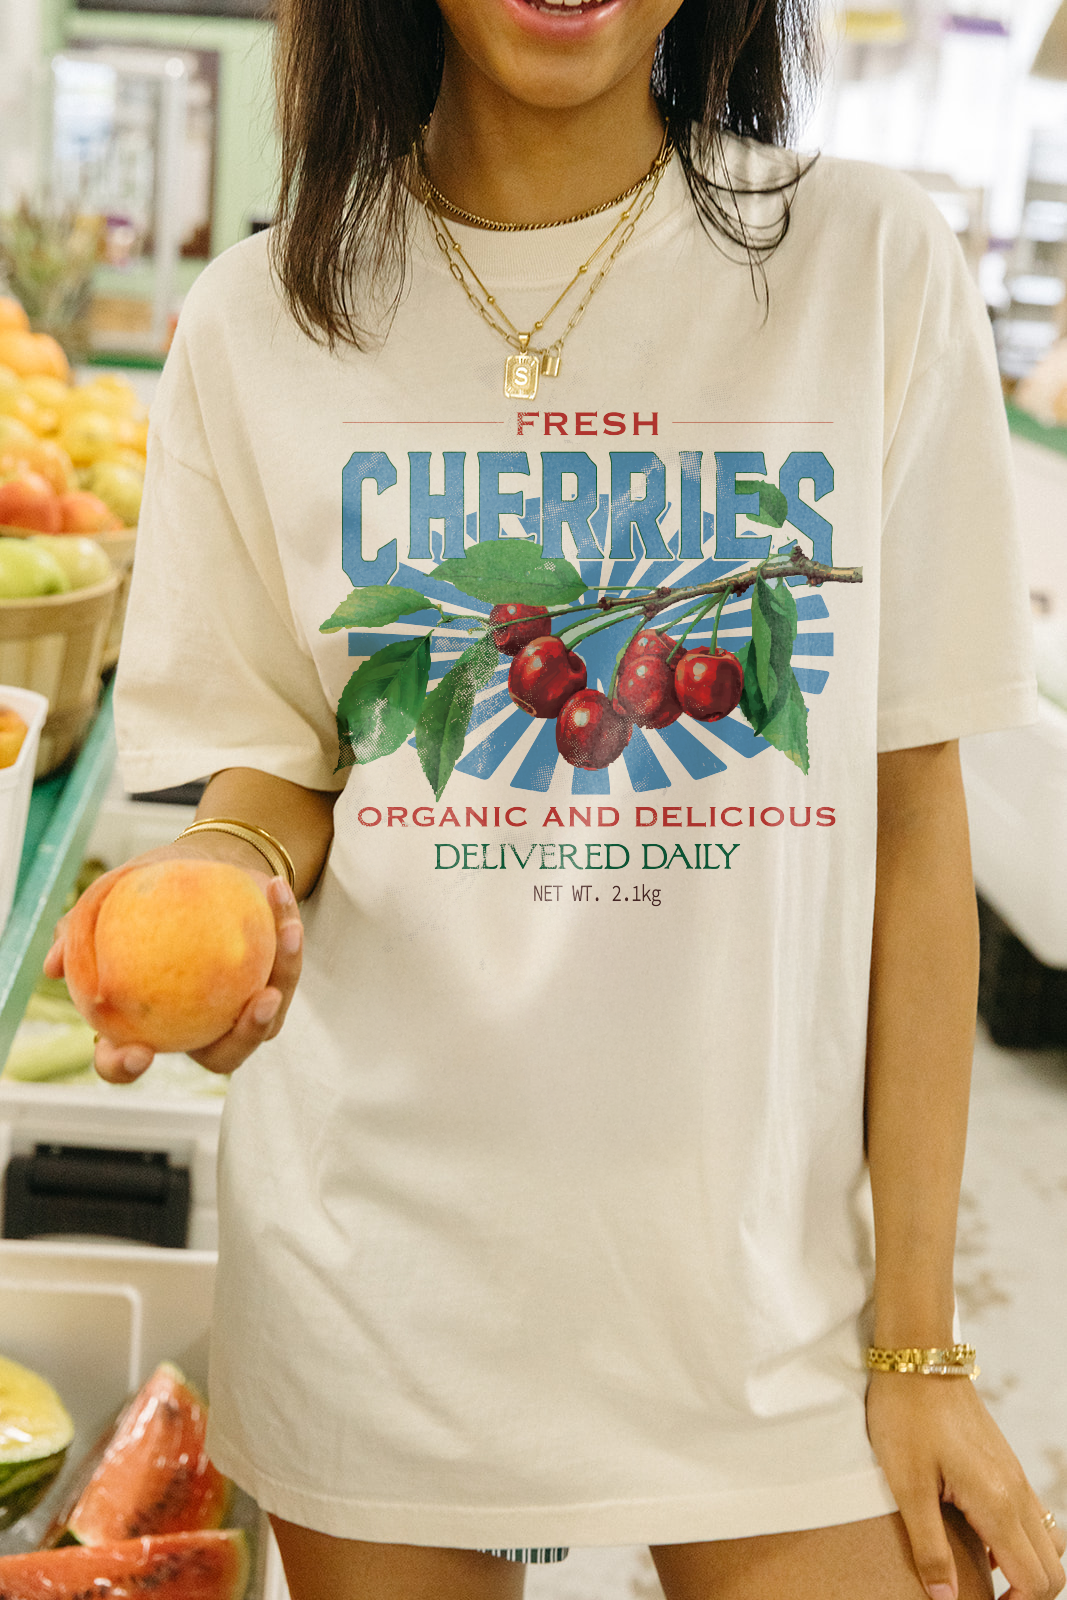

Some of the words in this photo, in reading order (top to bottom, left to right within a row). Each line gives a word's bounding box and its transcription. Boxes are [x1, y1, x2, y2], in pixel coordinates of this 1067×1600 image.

[514, 366, 528, 386] S
[516, 411, 660, 436] FRESH
[341, 451, 835, 588] CHERRIES
[357, 806, 528, 827] ORGANIC
[542, 806, 621, 827] AND
[634, 806, 837, 827] DELICIOUS
[434, 843, 630, 870] DELIVERED
[641, 843, 741, 870] DAILY
[533, 885, 563, 902] NET
[572, 885, 600, 902] WT.
[612, 884, 662, 907] 2.1kg
